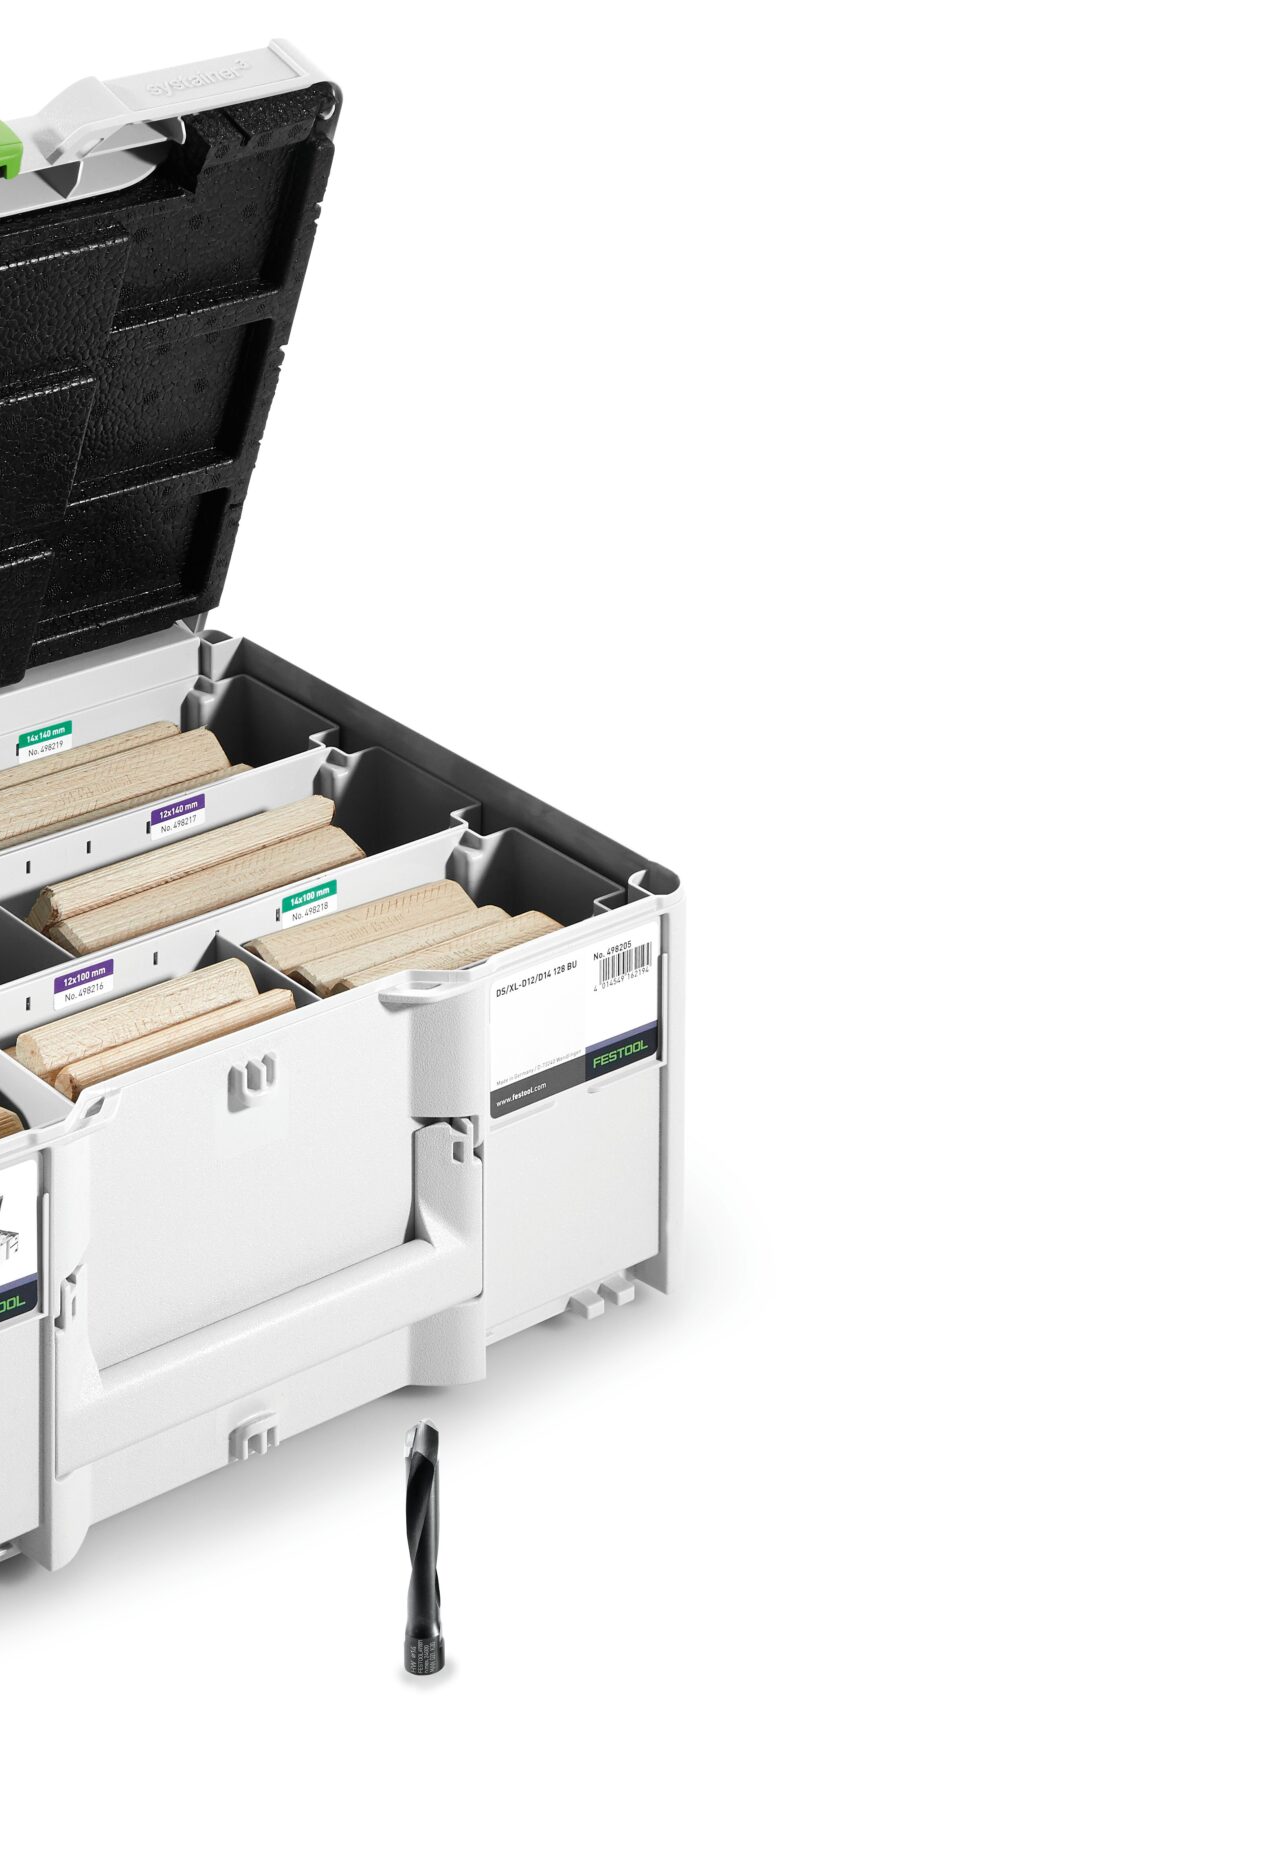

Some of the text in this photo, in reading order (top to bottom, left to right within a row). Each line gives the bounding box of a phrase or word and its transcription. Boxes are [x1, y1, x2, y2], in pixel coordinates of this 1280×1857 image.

[52, 727, 65, 736] mm
[28, 740, 63, 757] No. 498219
[160, 801, 198, 819] 12x140 mm
[161, 815, 196, 833] No. 498217
[291, 887, 330, 906] 14x100 mm
[292, 901, 328, 921] No. 498218
[594, 940, 631, 960] No. 498205
[64, 967, 106, 986] 12x100 mm
[496, 960, 577, 997] DS/XL-D12/D14 128 BU
[65, 982, 103, 1002] No. 498216
[593, 1040, 648, 1068] FESTOOL
[496, 1082, 546, 1107] www.festool.com
